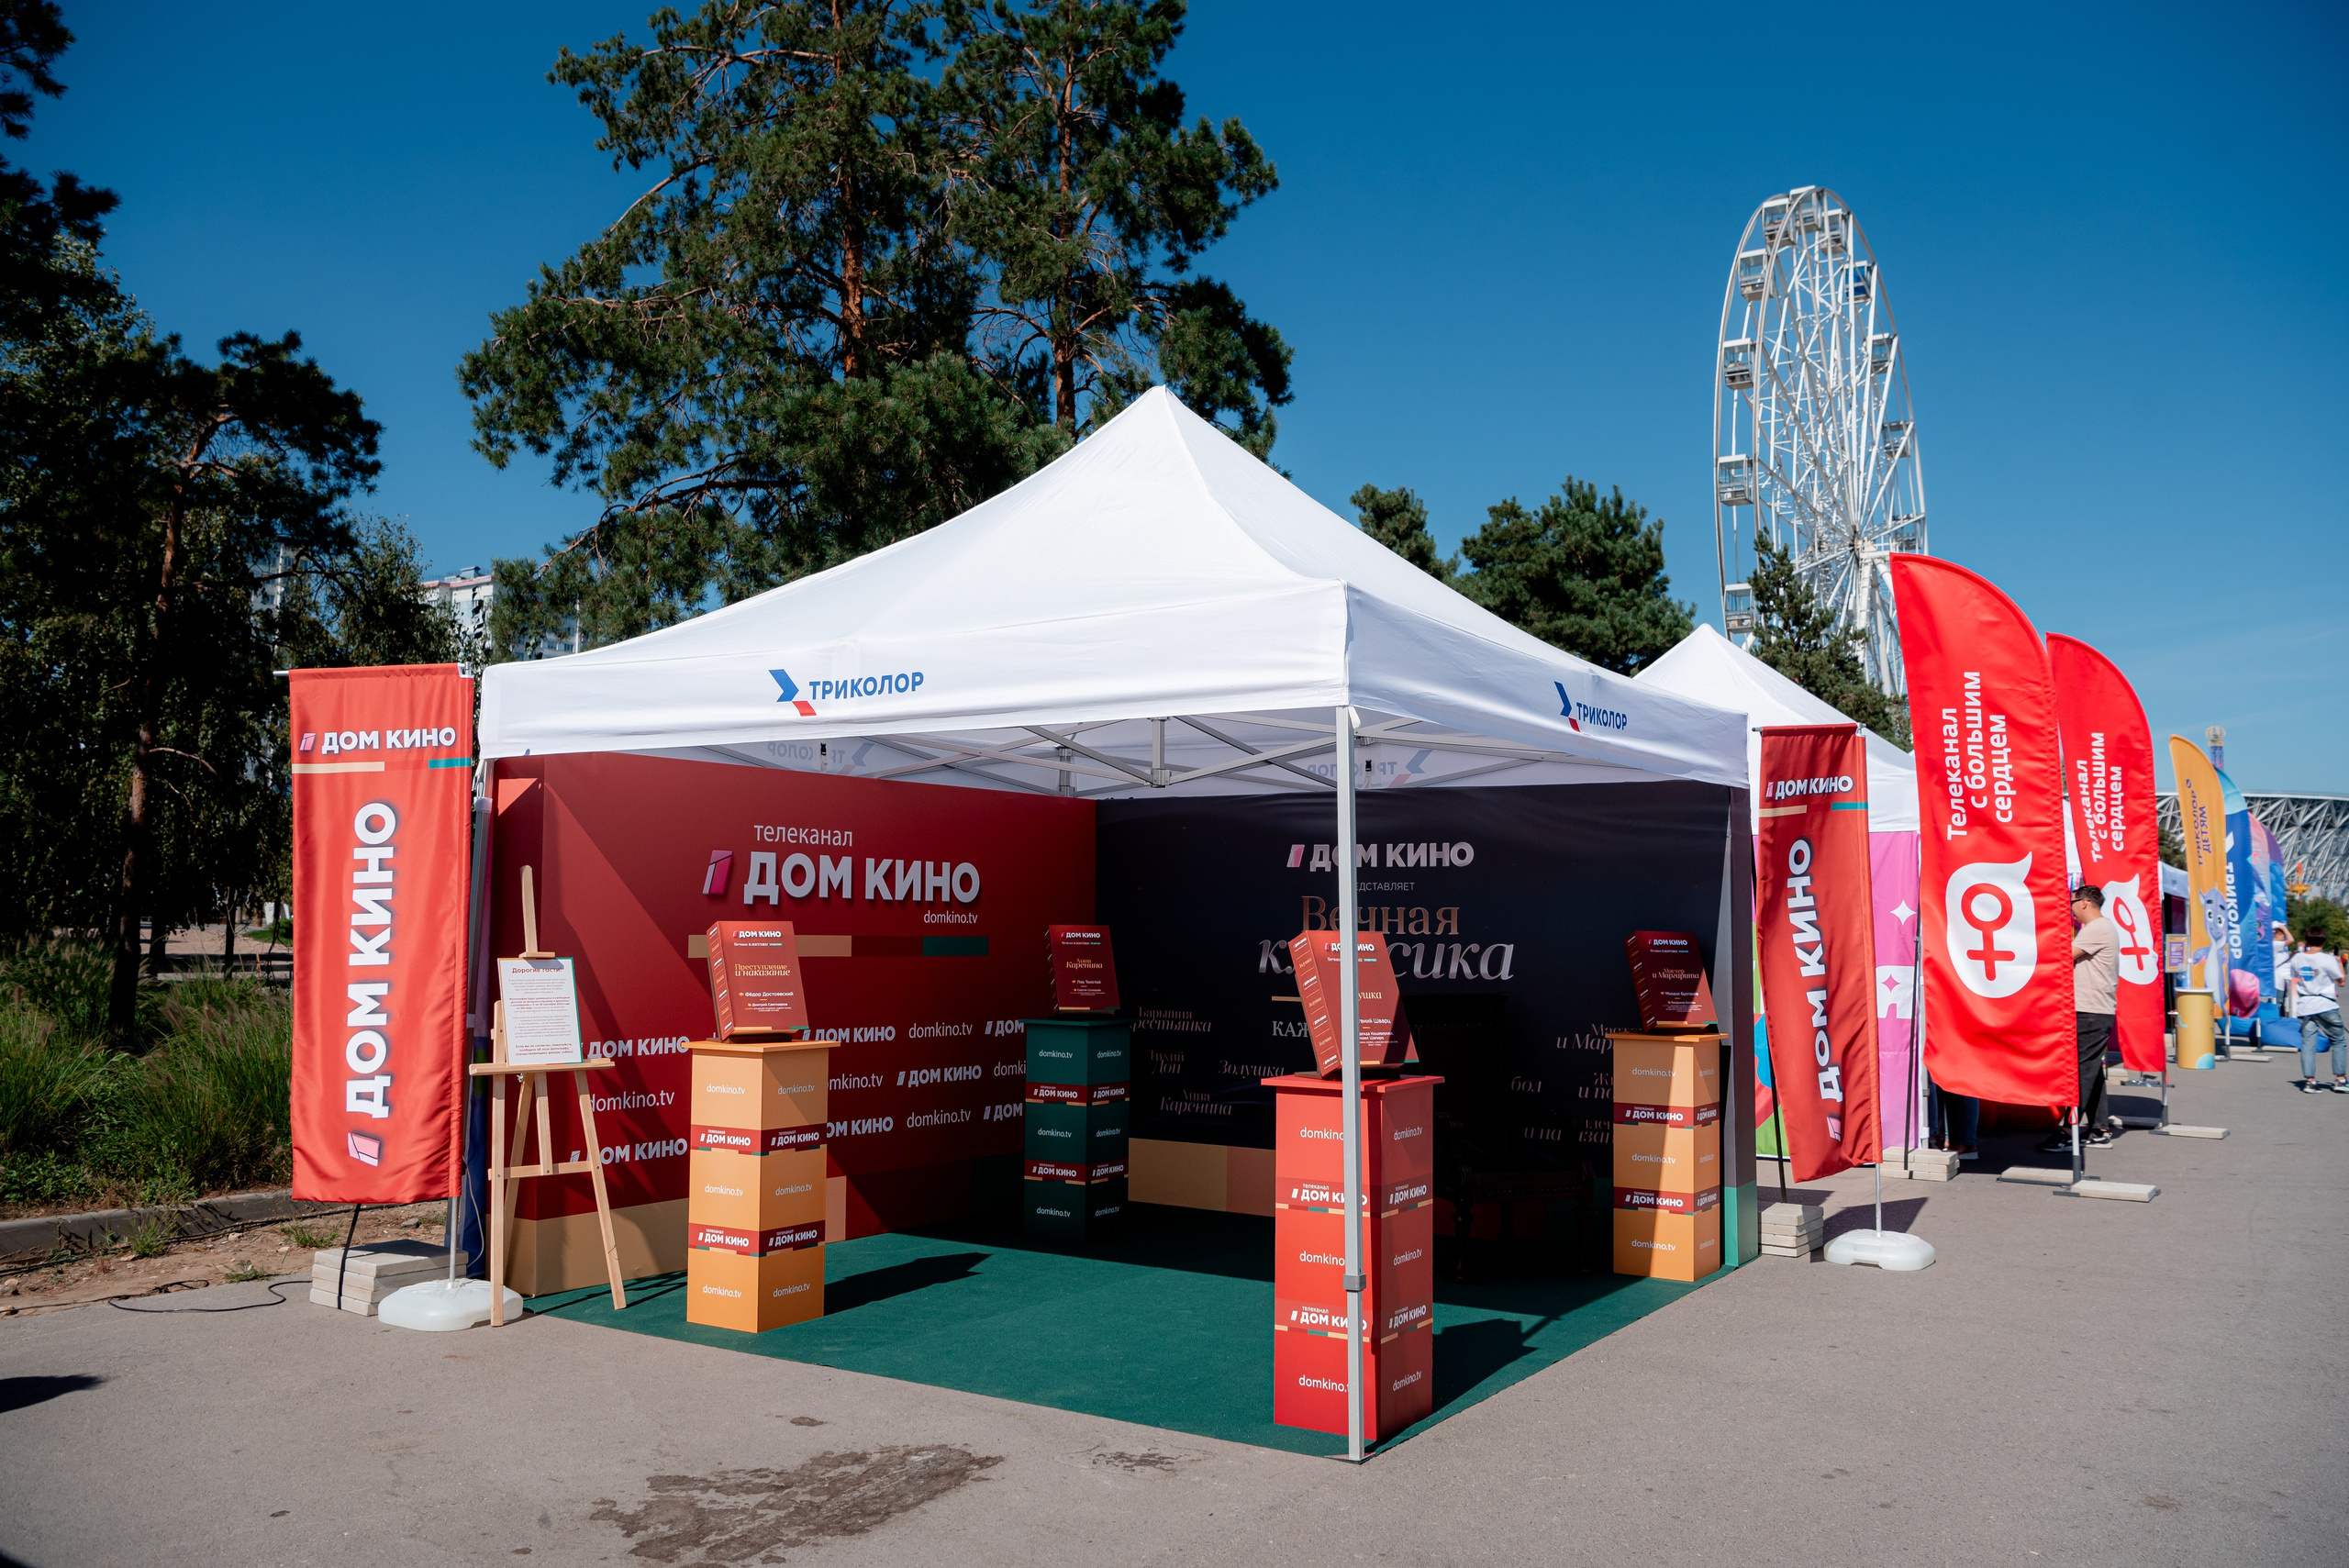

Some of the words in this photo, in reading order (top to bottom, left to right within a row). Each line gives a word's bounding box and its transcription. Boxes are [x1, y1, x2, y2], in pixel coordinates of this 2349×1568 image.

[808, 672, 924, 700] ТРИКОЛОР
[1576, 702, 1628, 730] ТРИКОЛОР
[1964, 672, 1987, 790] большим
[322, 730, 380, 755] ДОМ
[386, 727, 457, 749] КИНО
[1943, 708, 1967, 840] Телеканал
[1989, 715, 2016, 823] сердцем
[2091, 732, 2107, 825] большим
[1775, 779, 1808, 800] ДОМ
[1809, 775, 1854, 795] КИНО
[1971, 795, 1987, 808] с
[2110, 766, 2126, 851] сердцем
[2076, 760, 2103, 862] Телеканал
[754, 825, 852, 846] телеканал
[2098, 829, 2108, 840] с
[2191, 790, 2204, 866] ТРИКОЛОР
[2199, 806, 2212, 853] ДЕТЯМ
[1310, 844, 1377, 872] ДМ
[1386, 841, 1475, 867] КИНО
[349, 803, 396, 966] КИНО
[744, 851, 852, 905] ДОМ
[865, 858, 980, 903] КИНО
[924, 910, 978, 924] domkino.tv
[1787, 840, 1826, 977] КИНО
[2225, 862, 2243, 960] ТРИКОЛОР
[739, 930, 758, 939] ДОМ
[735, 963, 787, 972] Преступление
[1658, 972, 1699, 980] Маргарита
[815, 1029, 850, 1043] ДОМ
[853, 1026, 896, 1042] КИНО
[908, 1022, 973, 1038] domkino.tv
[995, 1020, 1024, 1037] ДОМ
[346, 983, 392, 1118] ДОМ
[587, 1040, 633, 1059] ДОМ
[638, 1036, 690, 1056] КИНО
[1039, 1050, 1073, 1058] domkino.tv
[1807, 989, 1843, 1102] ДОМ
[907, 1068, 941, 1087] ДОМ
[943, 1065, 982, 1083] КИНО
[1219, 1060, 1285, 1078] Золушка
[1631, 1067, 1675, 1077] domkino.tv
[707, 1084, 745, 1095] domkino.tv
[777, 1084, 815, 1095] domkino.tv
[1039, 1089, 1055, 1097] ДОМ
[1097, 1090, 1109, 1098] ДОМ
[1110, 1088, 1125, 1096] КИНО
[994, 1103, 1023, 1121] ДОМ
[1160, 1096, 1231, 1115] Каренина
[907, 1109, 971, 1128] domkino.tv
[1633, 1111, 1654, 1119] ДОМ
[1656, 1112, 1683, 1121] КИНО
[827, 1121, 847, 1138] ОМ
[852, 1117, 894, 1135] КИНО
[1038, 1128, 1072, 1138] domkino.tv
[1300, 1127, 1343, 1140] domkino
[1394, 1127, 1422, 1140] domkino.tv
[706, 1134, 726, 1144] ДОМ
[727, 1137, 751, 1146] КИНО
[777, 1136, 796, 1147] ДОМ
[796, 1132, 819, 1142] КИНО
[600, 1144, 630, 1165] ОМ
[635, 1138, 687, 1161] КИНО
[1631, 1153, 1675, 1163] domkino.tv
[1056, 1169, 1076, 1177] КИНО
[1097, 1167, 1108, 1177] ДОМ
[1109, 1164, 1124, 1173] КИНО
[705, 1184, 743, 1196] domkino.tv
[775, 1184, 812, 1196] domkino.tv
[1301, 1190, 1329, 1202] ДОМ
[1395, 1190, 1408, 1205] ДОМ
[1409, 1184, 1427, 1197] КИНО
[1632, 1195, 1654, 1205] ДОМ
[1656, 1197, 1683, 1207] КИНО
[1037, 1207, 1071, 1217] domkino.tv
[705, 1234, 724, 1245] ДОМ
[725, 1237, 749, 1247] КИНО
[774, 1234, 794, 1247] ДОМ
[795, 1229, 818, 1241] КИНО
[1631, 1239, 1675, 1251] domkino.tv
[1299, 1251, 1345, 1266] domkino
[1394, 1249, 1422, 1266] domkino.tv
[703, 1284, 741, 1297] domkino.tv
[774, 1283, 810, 1297] domkino.tv
[1302, 1306, 1329, 1314] телеканал
[1394, 1312, 1408, 1329] ДОМ
[1409, 1305, 1426, 1320] КИНО
[1300, 1312, 1329, 1326] ДОМ
[1393, 1371, 1421, 1391] domkino.tv
